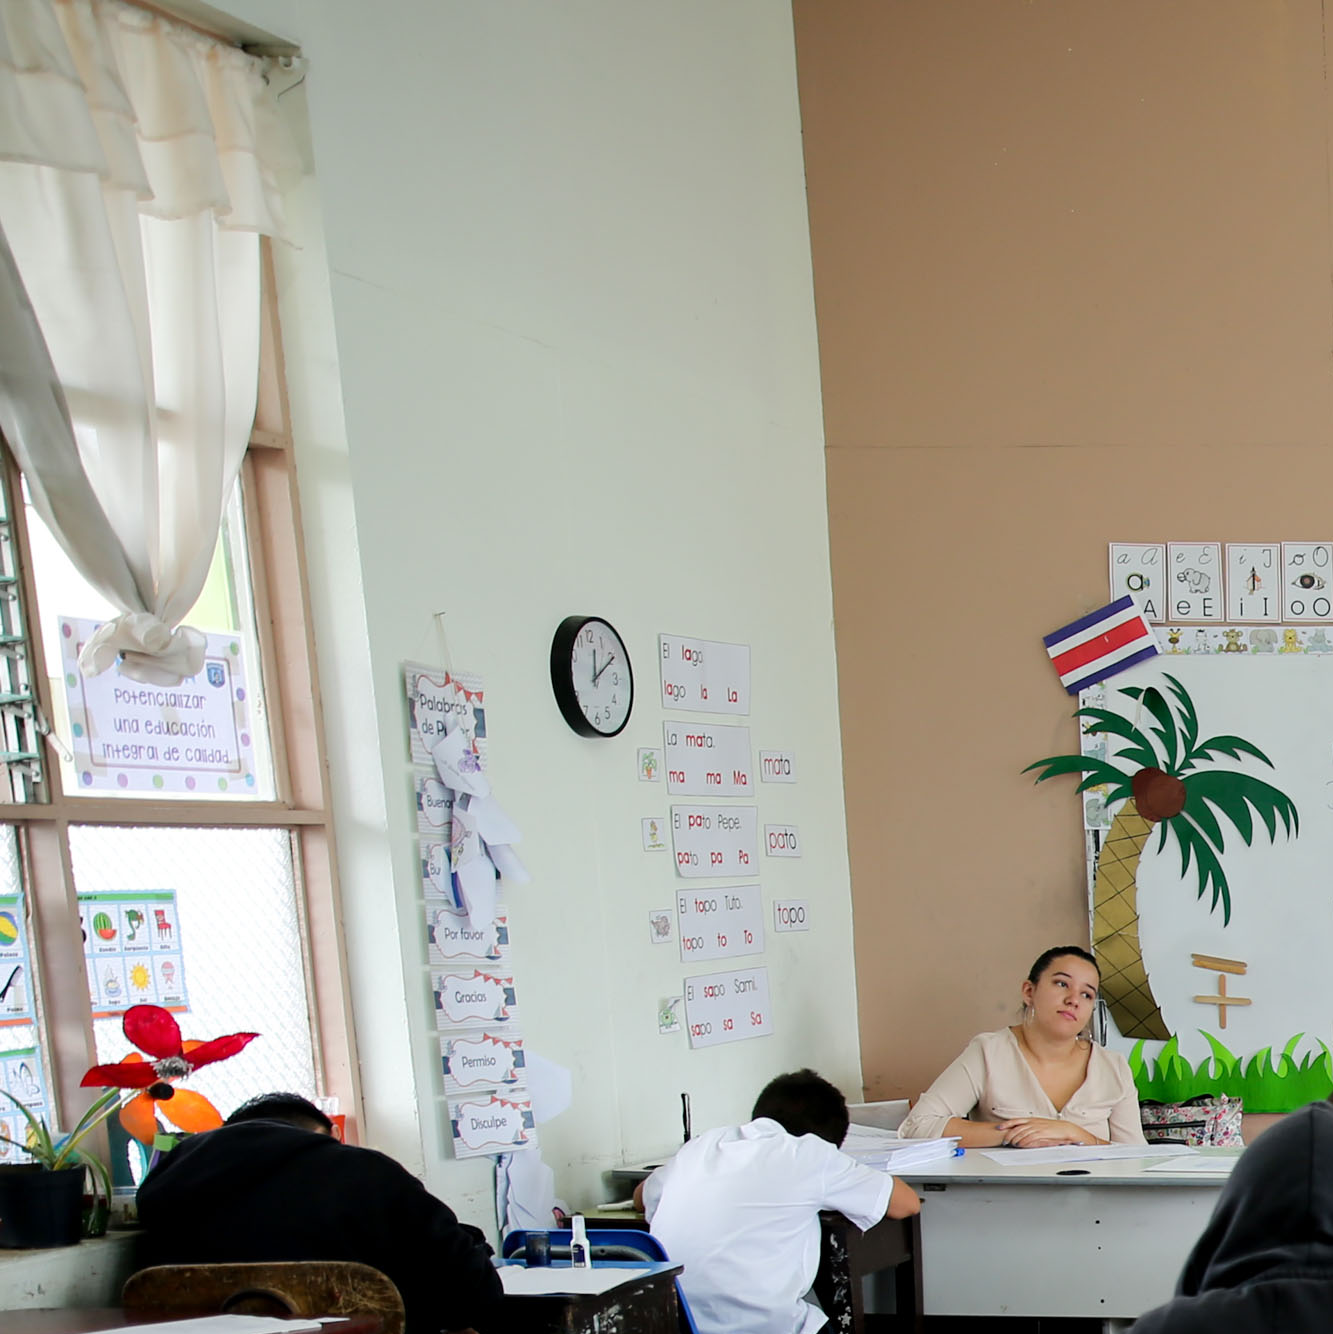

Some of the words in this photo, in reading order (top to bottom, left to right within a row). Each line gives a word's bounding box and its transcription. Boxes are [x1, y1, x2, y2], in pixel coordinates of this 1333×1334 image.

[1202, 598, 1214, 616] E
[664, 680, 686, 702] lago
[700, 684, 708, 700] la
[727, 688, 738, 702] La
[114, 718, 140, 733] una
[144, 719, 216, 739] educación
[422, 719, 434, 734] de
[666, 728, 678, 746] La
[164, 743, 180, 758] de
[764, 754, 790, 776] mata
[669, 770, 685, 783] ma
[706, 772, 722, 784] ma
[733, 770, 747, 785] Ma
[688, 814, 712, 830] pato
[769, 828, 797, 854] pato
[677, 850, 698, 868] pato
[710, 852, 723, 867] pa
[738, 850, 749, 864] Pa
[694, 898, 718, 916] topo
[777, 904, 806, 928] topo
[444, 927, 459, 941] Por
[460, 928, 484, 940] favor
[682, 936, 704, 952] topo
[718, 932, 727, 948] to
[744, 930, 752, 945] To
[454, 990, 487, 1004] Gracias
[704, 984, 726, 1000] sapo
[690, 1022, 712, 1038] sapo
[723, 1018, 734, 1031] sa
[750, 1010, 762, 1026] Sa
[462, 1055, 496, 1068] Permiso
[470, 1116, 508, 1130] Disculpe
